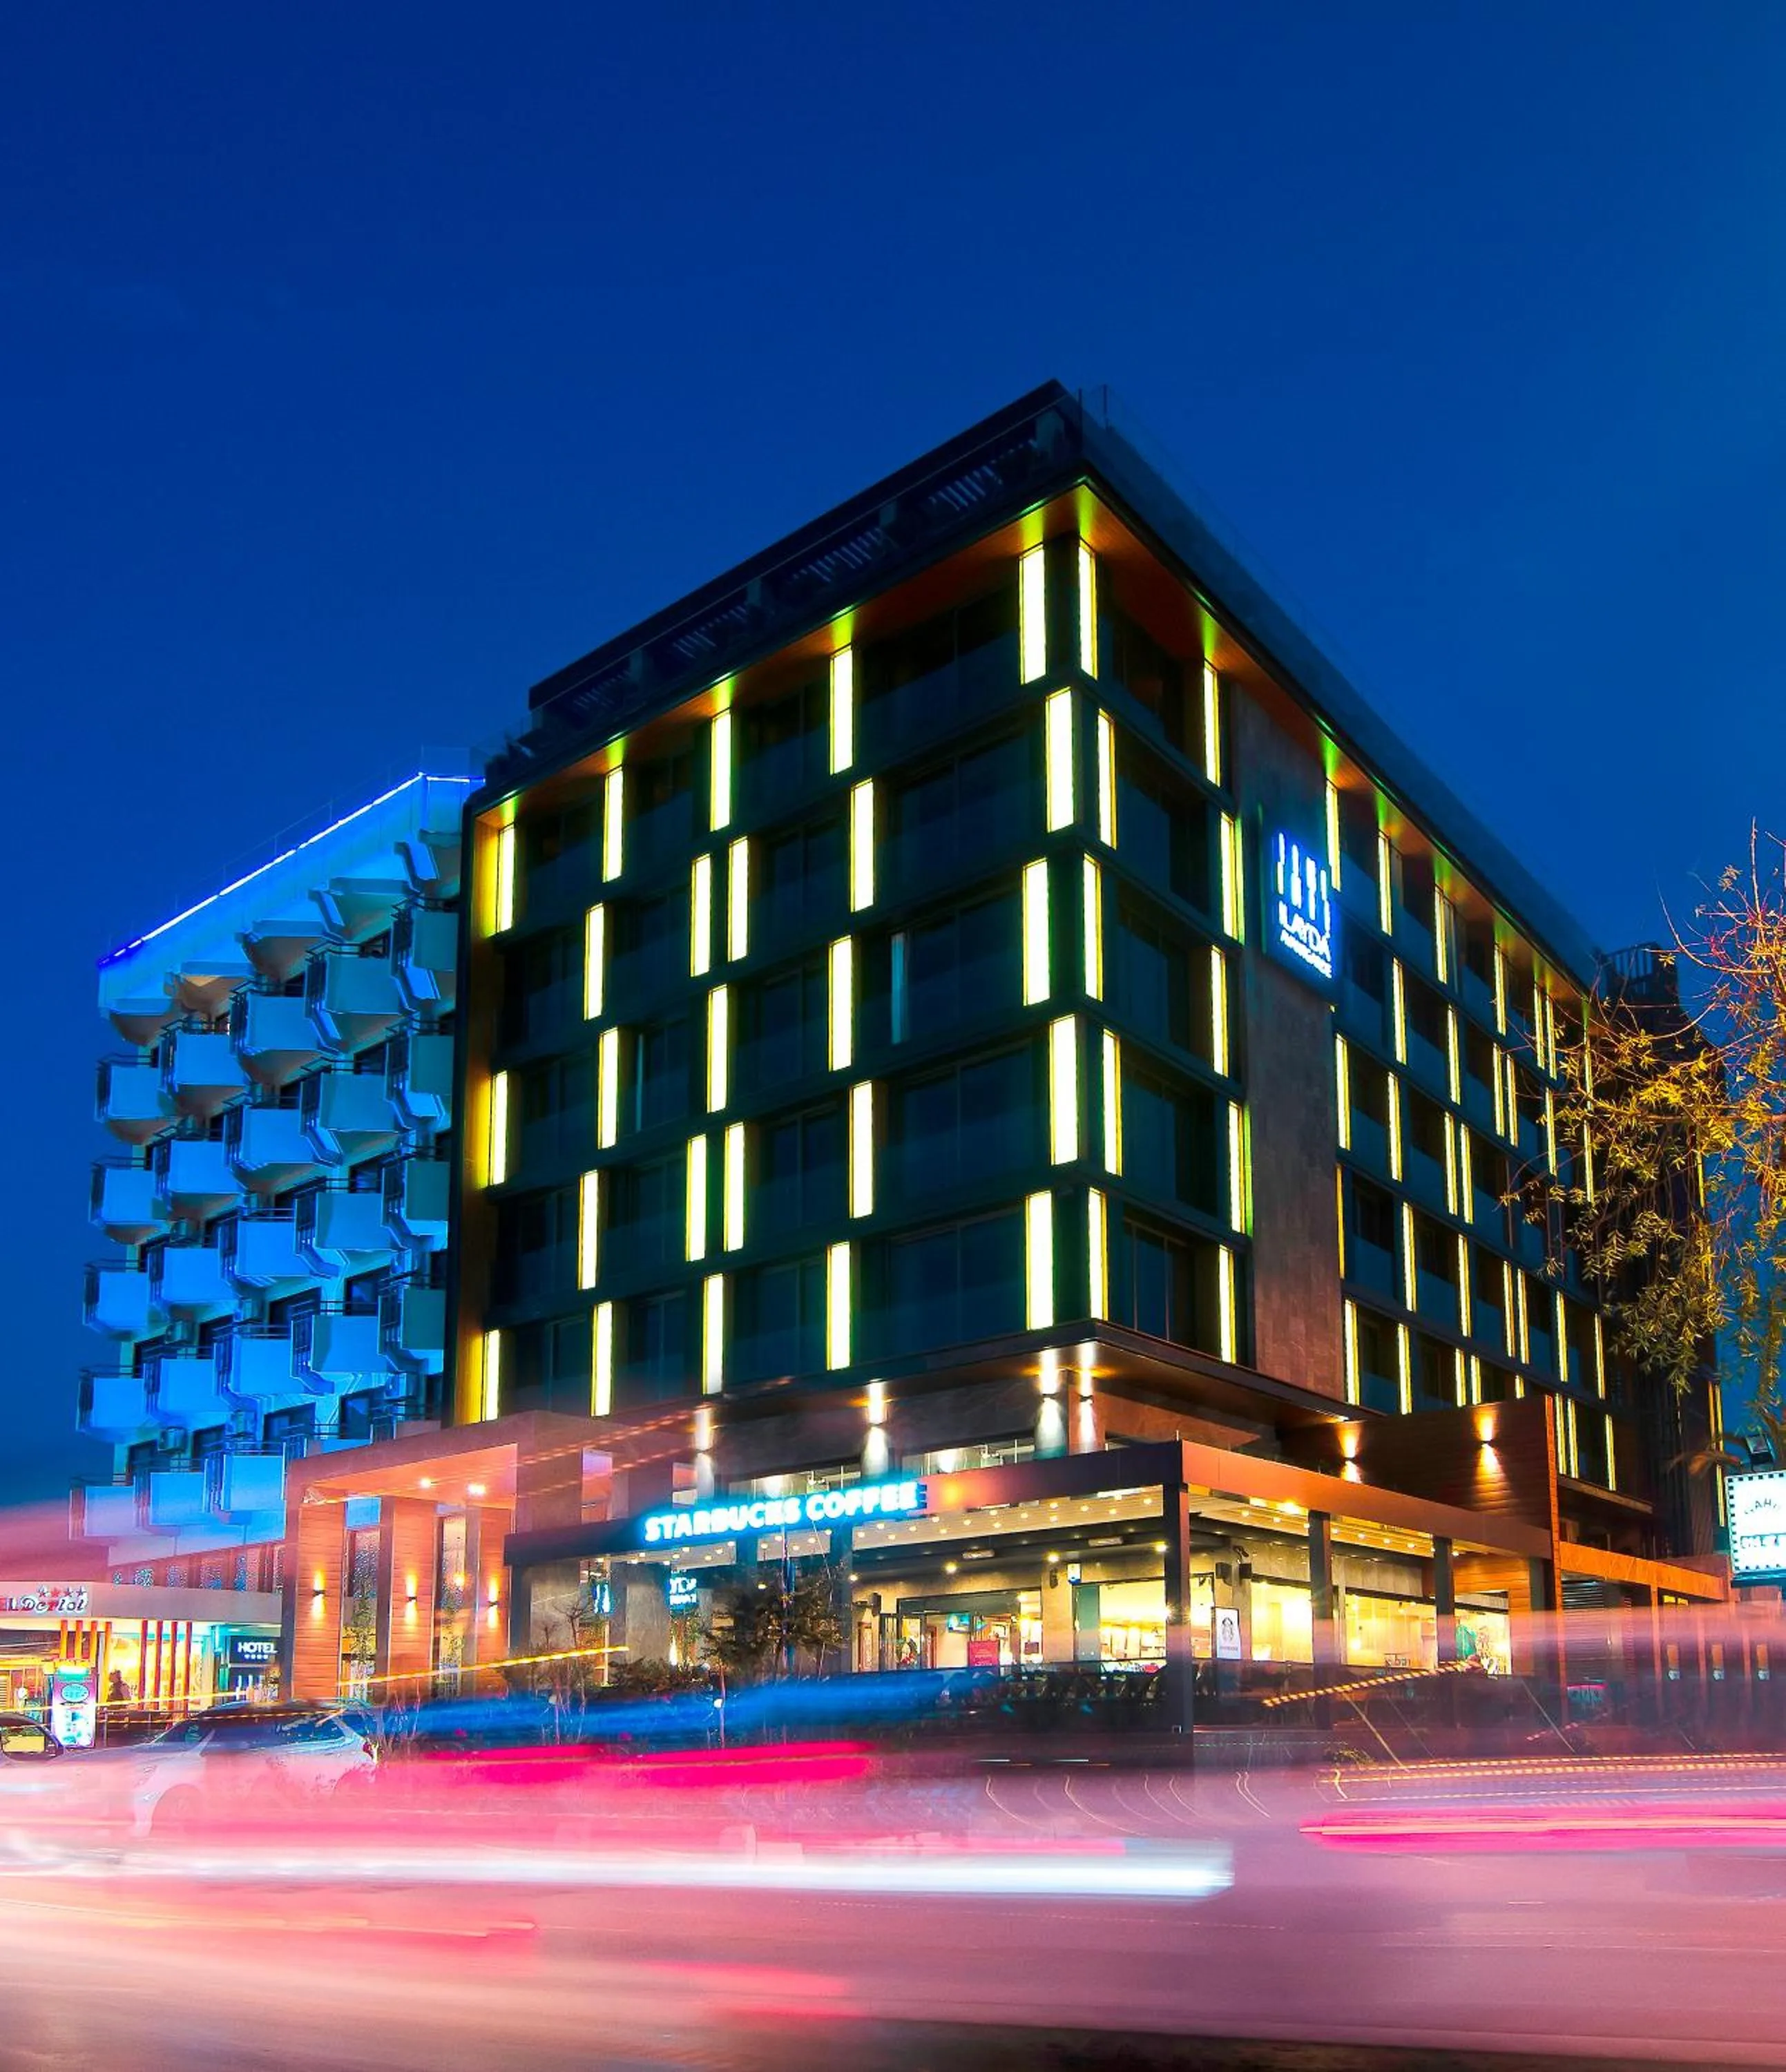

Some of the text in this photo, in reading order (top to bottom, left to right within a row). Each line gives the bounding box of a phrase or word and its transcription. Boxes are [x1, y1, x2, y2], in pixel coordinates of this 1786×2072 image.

[644, 1481, 921, 1542] STARBUCKS COFFEE
[237, 1641, 278, 1654] HOTEL
